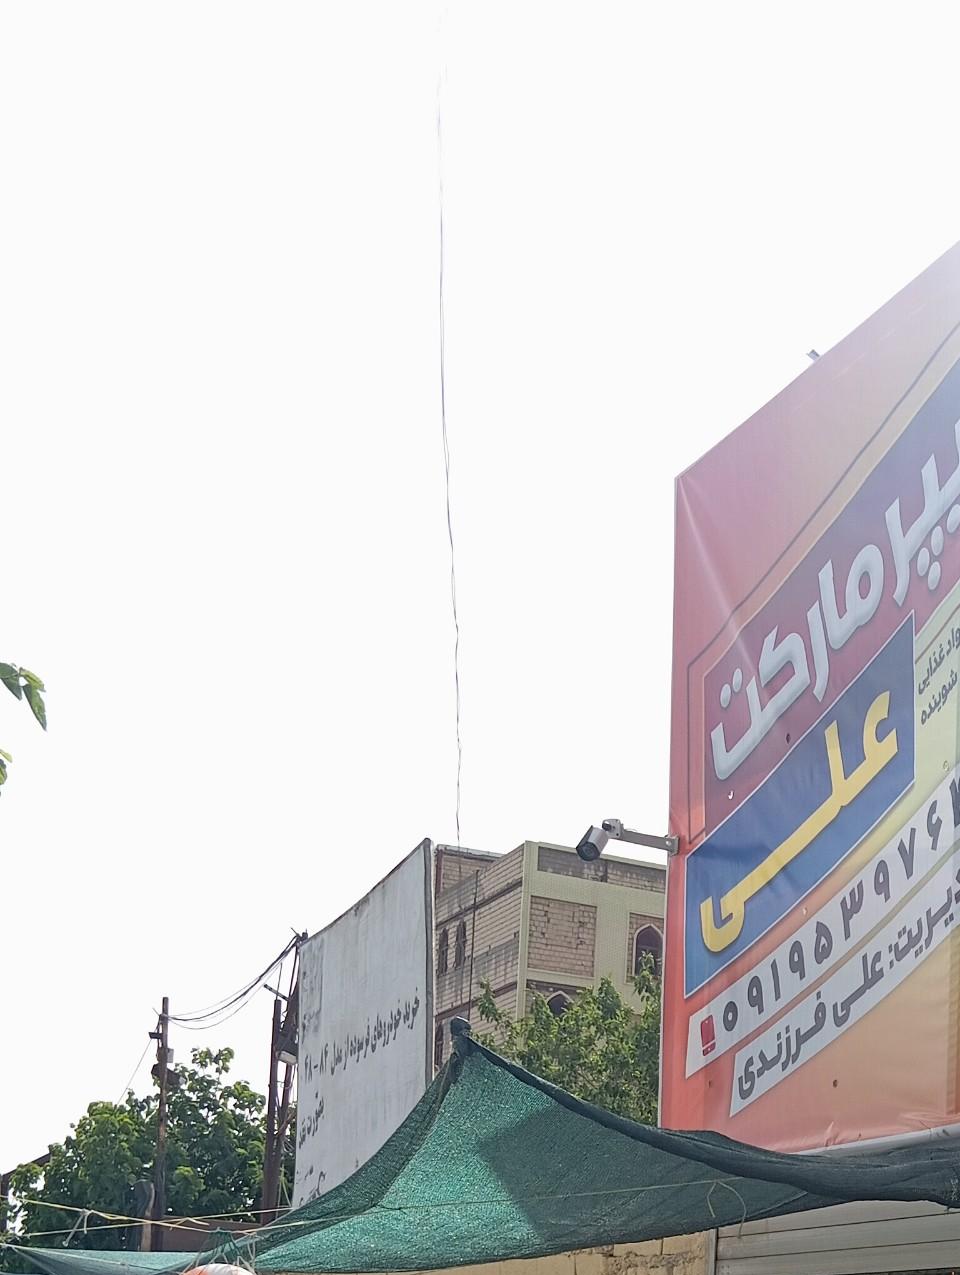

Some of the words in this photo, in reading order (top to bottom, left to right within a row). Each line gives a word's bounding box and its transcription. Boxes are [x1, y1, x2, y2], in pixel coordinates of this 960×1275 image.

[918, 642, 947, 695] غذایی
[920, 669, 958, 725] شوینده
[699, 691, 898, 953] علی
[832, 952, 884, 1029] علی
[737, 990, 827, 1101] فرزندی
